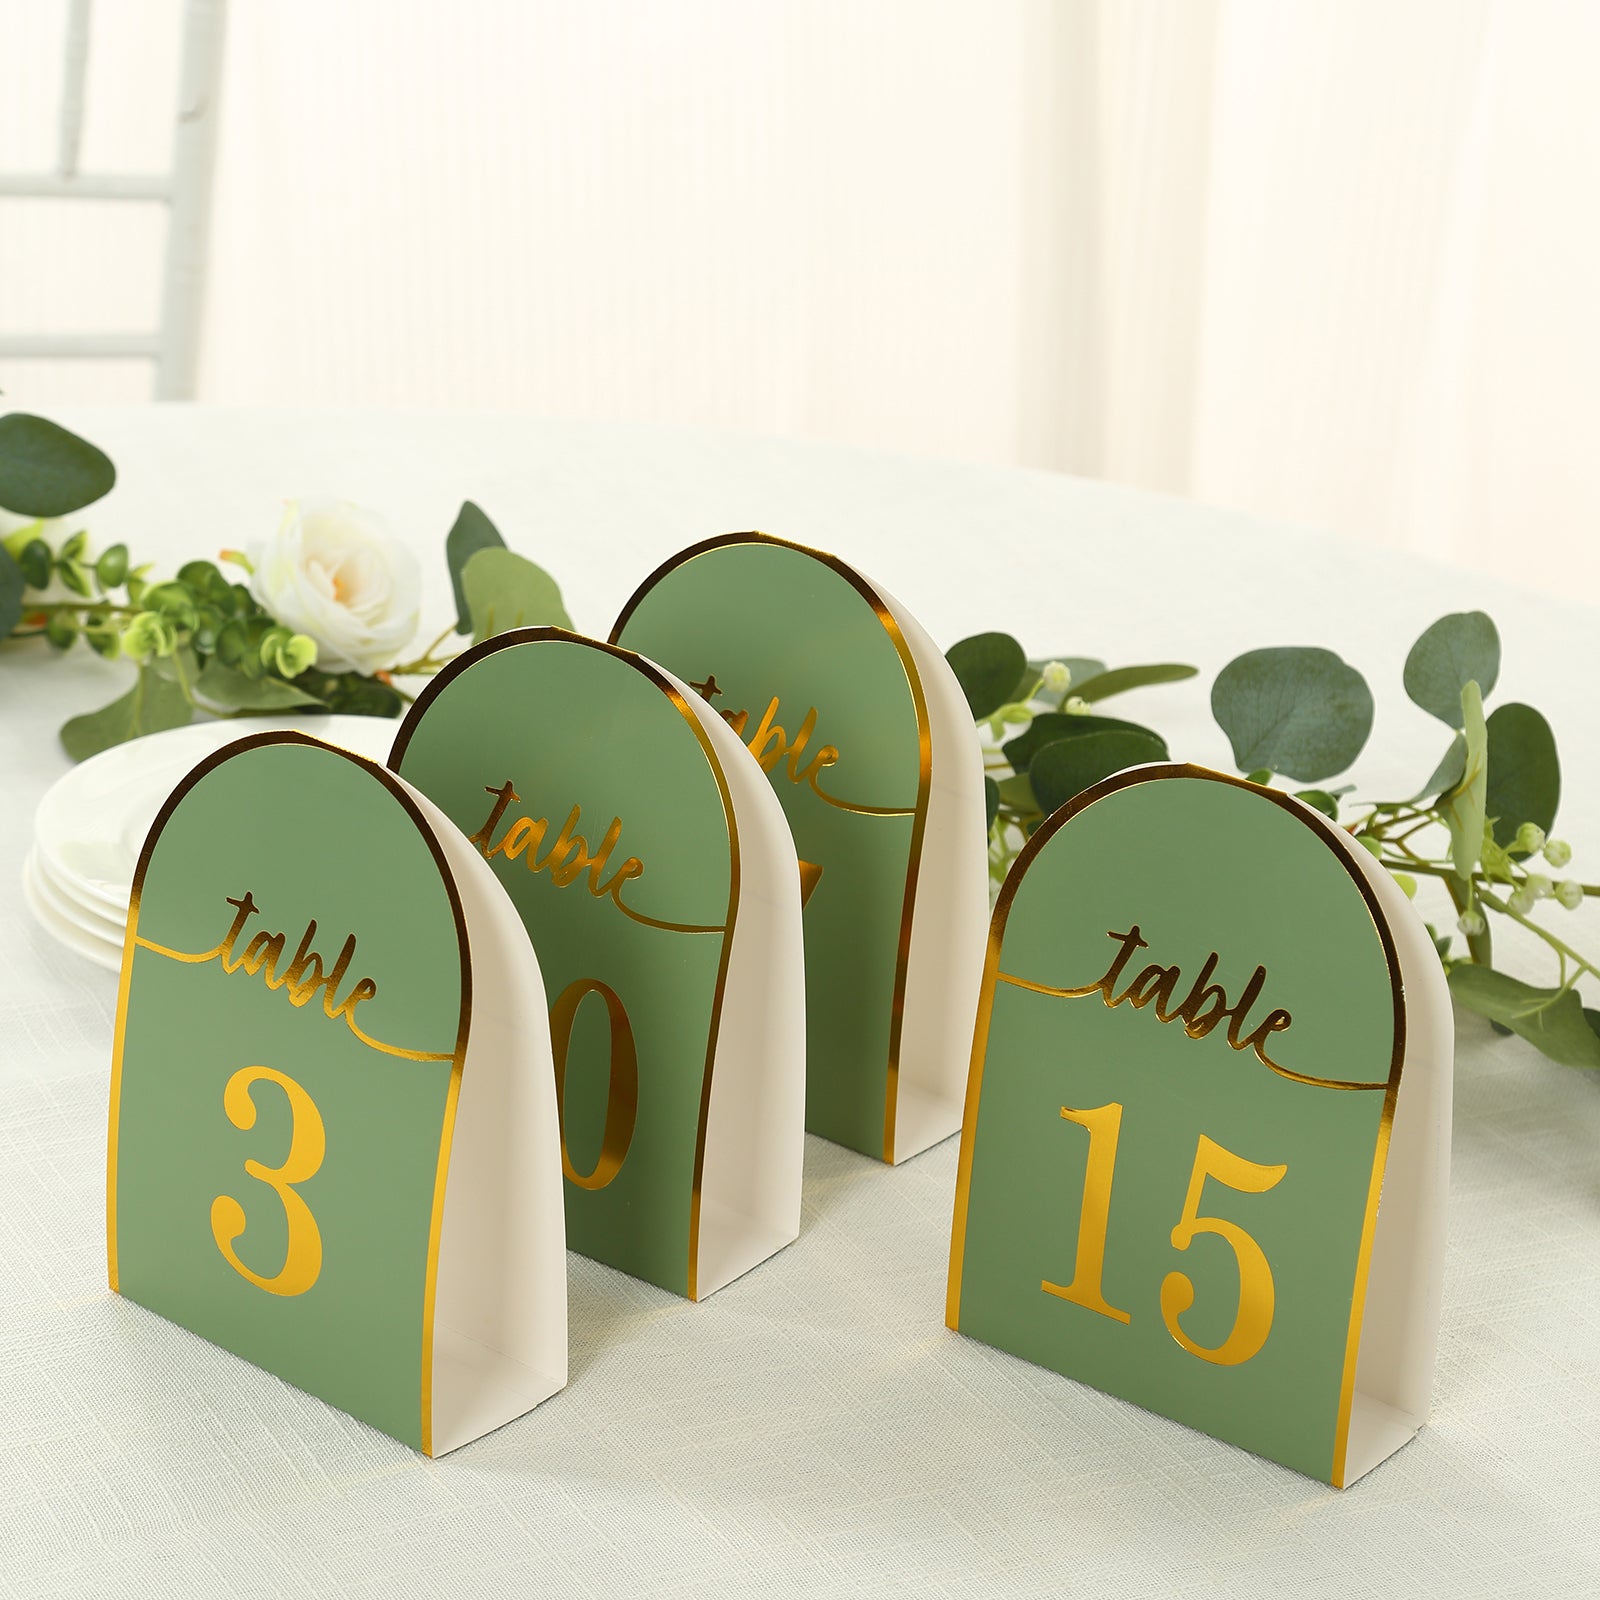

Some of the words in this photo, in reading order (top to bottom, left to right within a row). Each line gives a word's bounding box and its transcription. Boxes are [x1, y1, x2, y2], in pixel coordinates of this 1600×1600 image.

[472, 779, 644, 902] table
[222, 890, 378, 1024] table
[1102, 924, 1293, 1056] table
[548, 977, 640, 1190] 0
[209, 1065, 327, 1297] 3
[1040, 1101, 1289, 1367] 15
